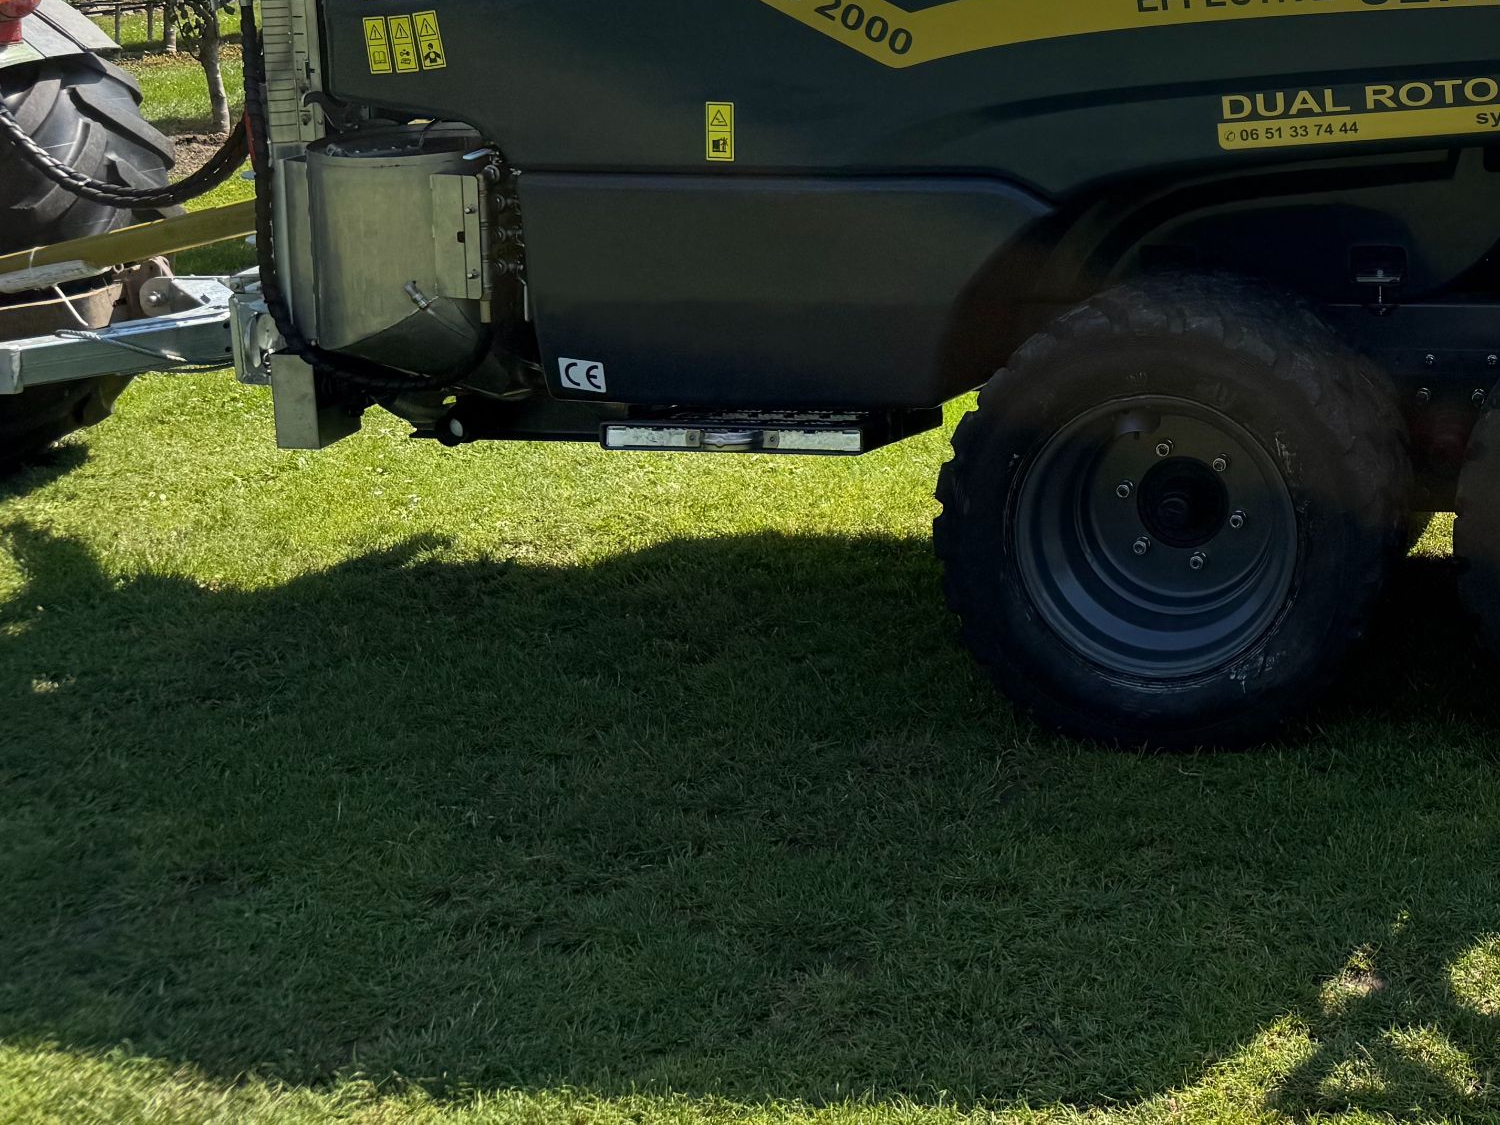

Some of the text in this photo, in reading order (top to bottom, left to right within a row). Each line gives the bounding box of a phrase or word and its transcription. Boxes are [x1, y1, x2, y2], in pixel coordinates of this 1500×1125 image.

[1222, 88, 1351, 120] DUAL
[1239, 121, 1359, 142] 06 51 33 74 44
[565, 362, 602, 389] CE
